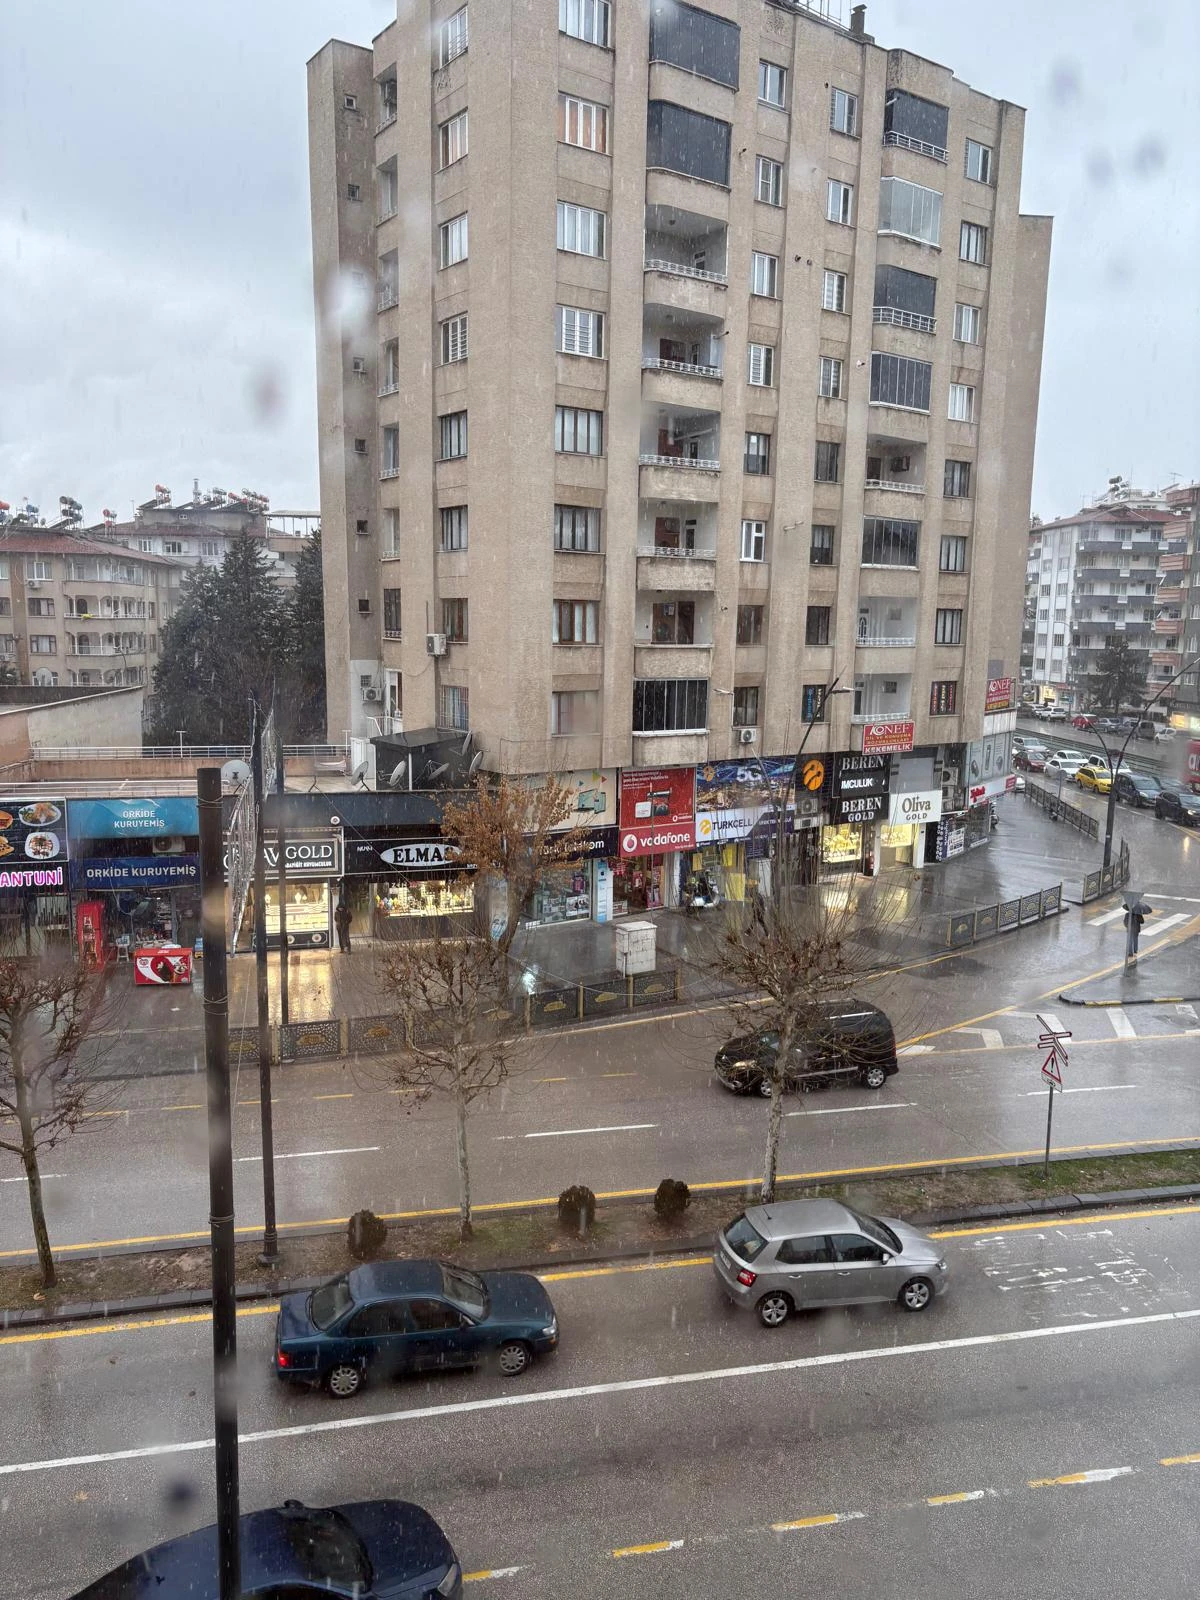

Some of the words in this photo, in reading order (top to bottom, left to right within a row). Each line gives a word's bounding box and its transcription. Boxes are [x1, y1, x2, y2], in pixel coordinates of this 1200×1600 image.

[842, 755, 885, 770] BEREN
[842, 797, 882, 813] BEREN
[902, 796, 931, 813] Oliva
[122, 808, 156, 819] ORKİDE
[848, 811, 874, 823] GOLD
[906, 812, 928, 821] GOLD
[114, 818, 165, 829] KURUYEMİŞ
[640, 832, 691, 847] vodafone
[285, 845, 333, 859] GOLD
[87, 866, 129, 878] ORKİDE
[132, 864, 197, 877] KURUYEMİŞ
